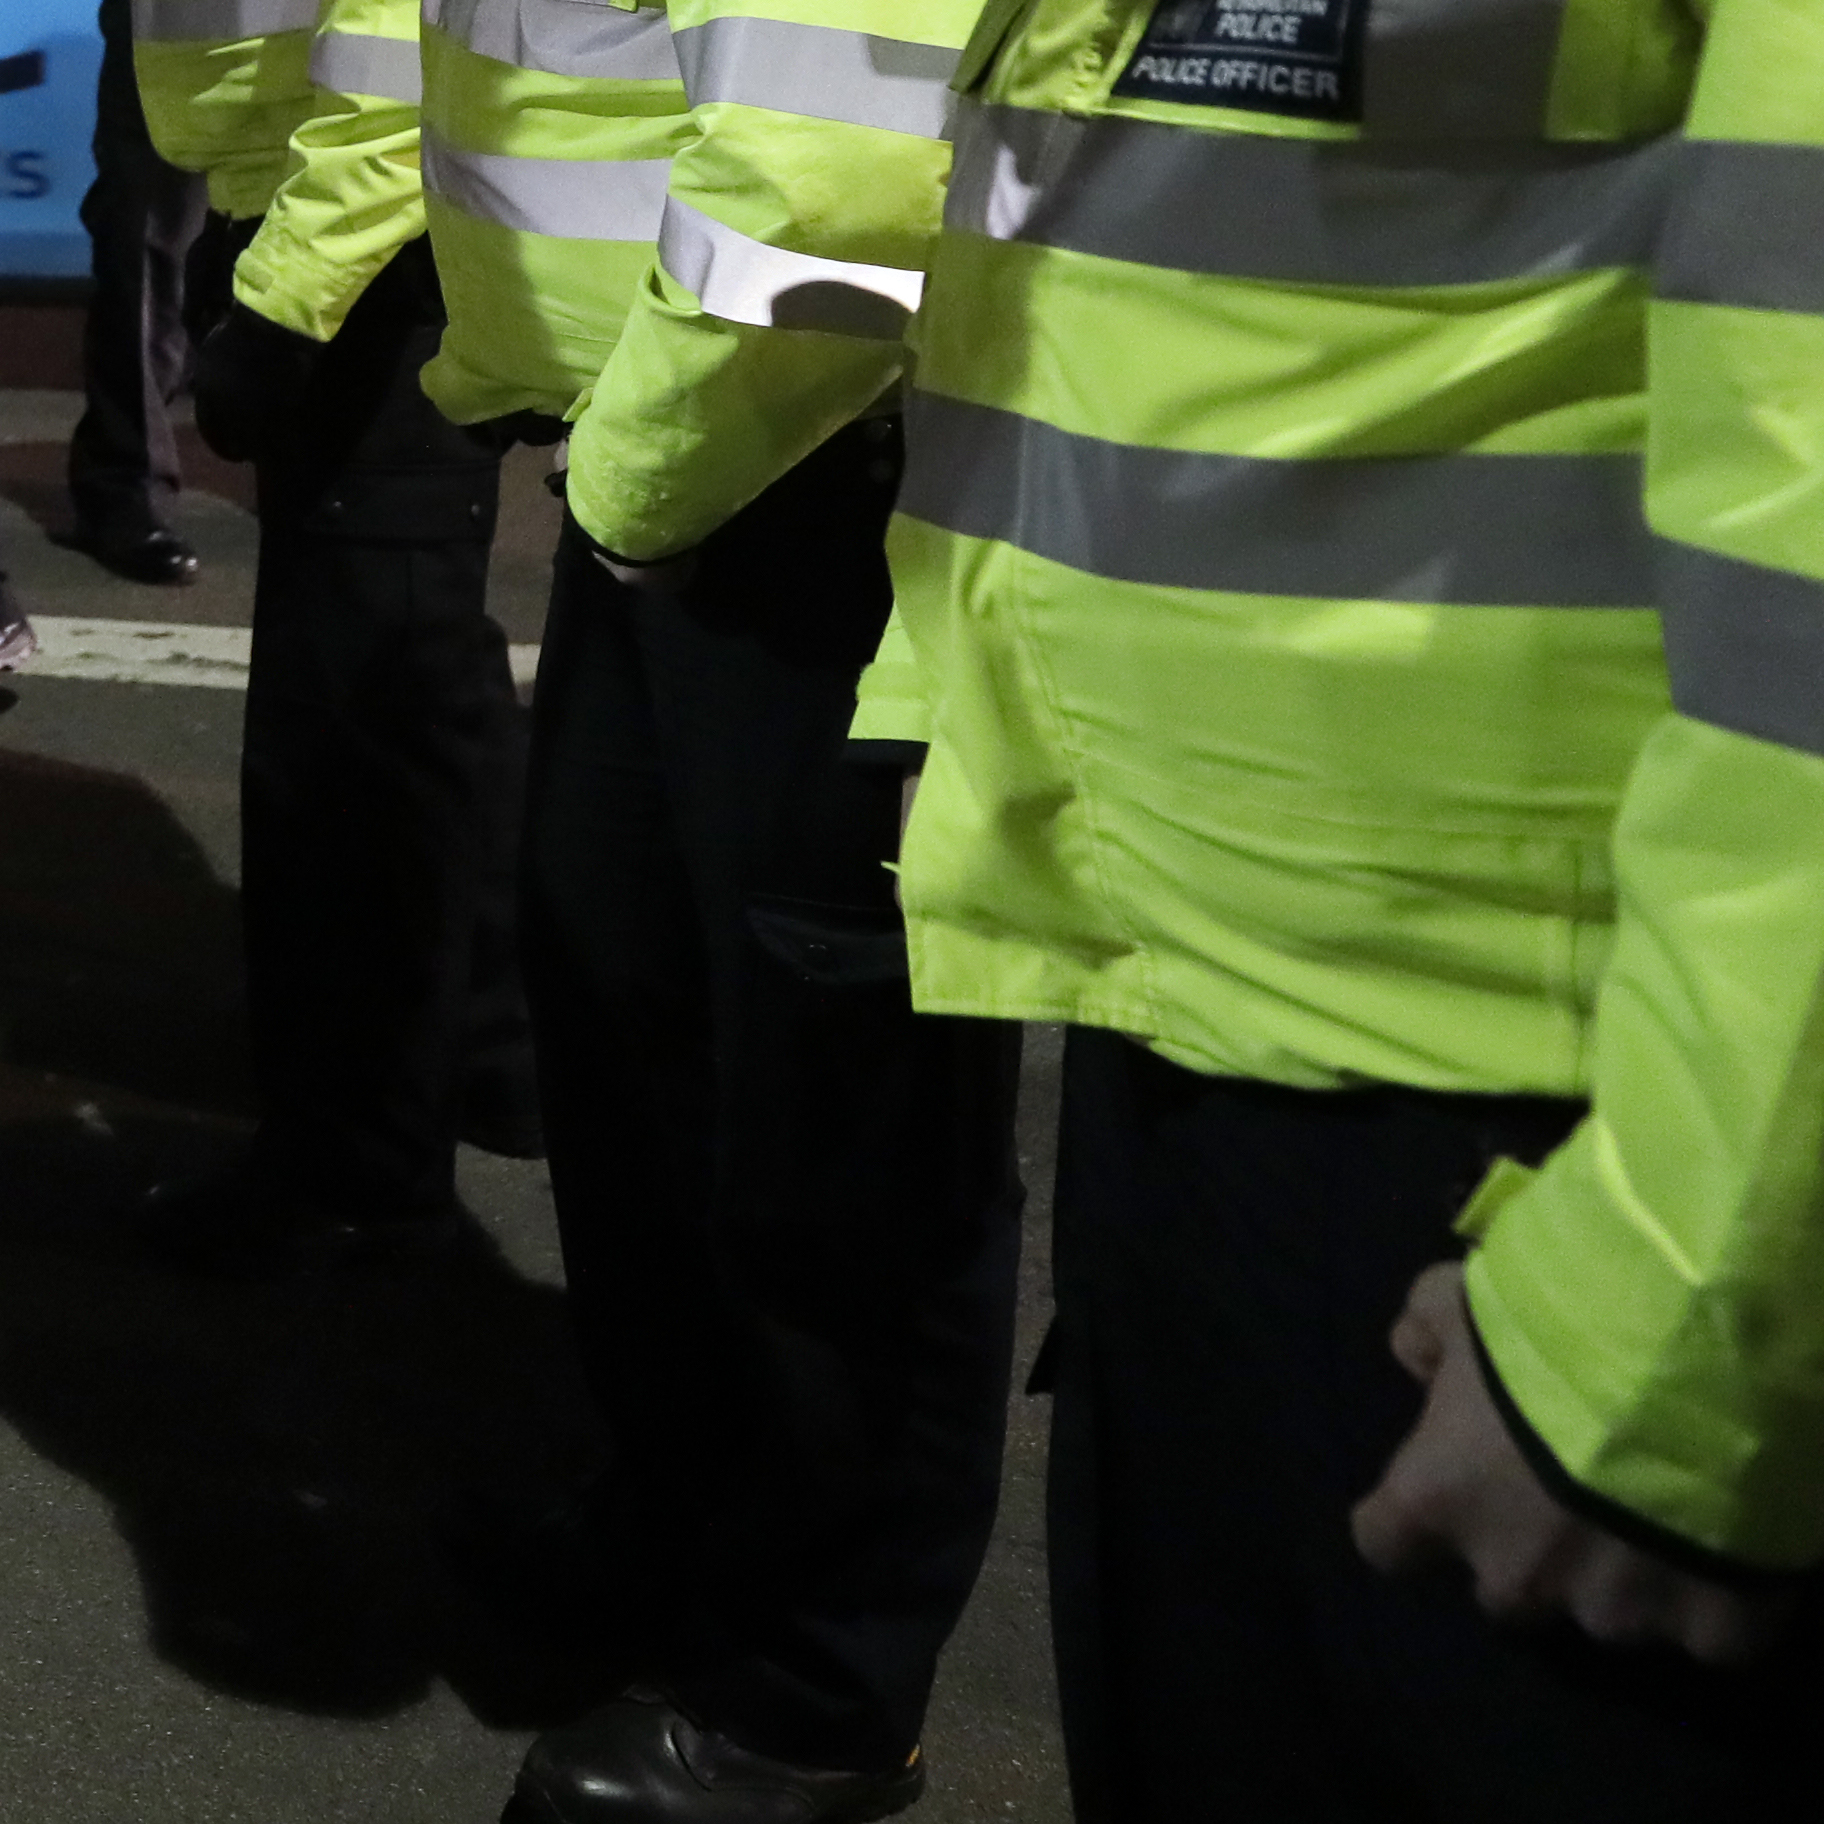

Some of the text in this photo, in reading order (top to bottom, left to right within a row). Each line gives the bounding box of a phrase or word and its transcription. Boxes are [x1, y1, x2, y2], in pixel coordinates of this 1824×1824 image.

[1214, 12, 1301, 43] POLICE
[1132, 56, 1340, 100] POLICE OFFICER
